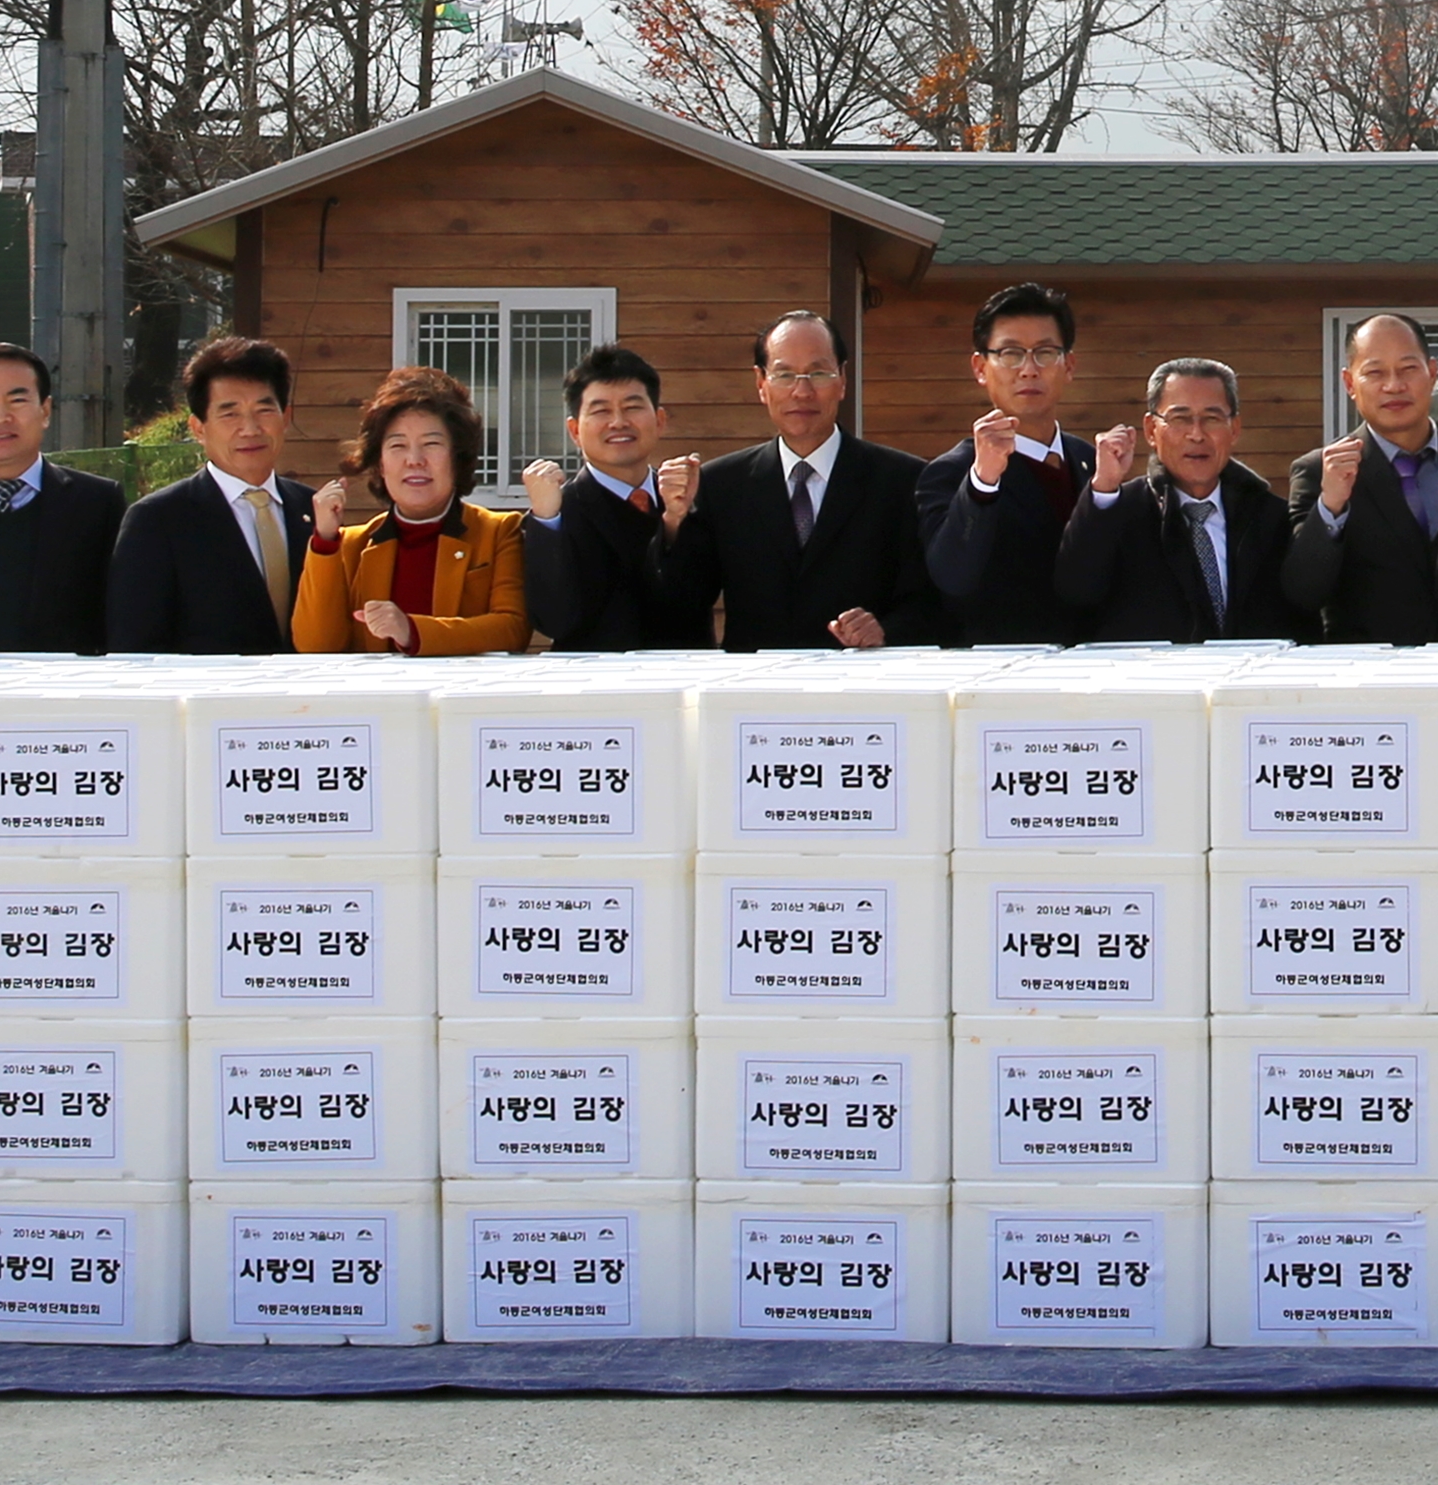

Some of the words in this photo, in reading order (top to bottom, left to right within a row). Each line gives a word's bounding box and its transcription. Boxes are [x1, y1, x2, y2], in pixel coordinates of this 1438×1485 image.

[294, 739, 330, 750] 겨울나기
[817, 735, 854, 747] 겨울나기
[225, 767, 300, 794] 사랑의
[317, 766, 368, 792] 김장
[746, 763, 823, 790] 사랑의
[840, 764, 893, 790] 김장
[243, 811, 349, 826] 하동군여성단체협의회
[764, 809, 873, 822] 하동군여성단체협의회
[555, 899, 592, 911] 겨울나기
[1074, 905, 1112, 916] 겨울나기
[484, 927, 560, 953] 사랑의
[577, 928, 630, 954] 김장
[1002, 932, 1080, 959] 사랑의
[1097, 933, 1150, 960] 김장
[502, 972, 609, 986] 하동군여성단체협의회
[1020, 978, 1130, 991] 하동군여성단체협의회
[296, 1066, 332, 1078] 겨울나기
[823, 1075, 860, 1086] 겨울나기
[227, 1094, 302, 1121] 사랑의
[319, 1093, 370, 1119] 김장
[750, 1102, 828, 1128] 사랑의
[845, 1103, 898, 1130] 김장
[246, 1138, 352, 1153] 하동군여성단체협의회
[768, 1147, 877, 1161] 하동군여성단체협의회
[550, 1231, 586, 1242] 겨울나기
[1074, 1233, 1111, 1244] 겨울나기
[480, 1259, 556, 1286] 사랑의
[573, 1259, 625, 1285] 김장
[1002, 1260, 1080, 1287] 사랑의
[1097, 1261, 1150, 1288] 김장
[499, 1304, 606, 1318] 하동군여성단체협의회
[1020, 1306, 1130, 1320] 하동군여성단체협의회
